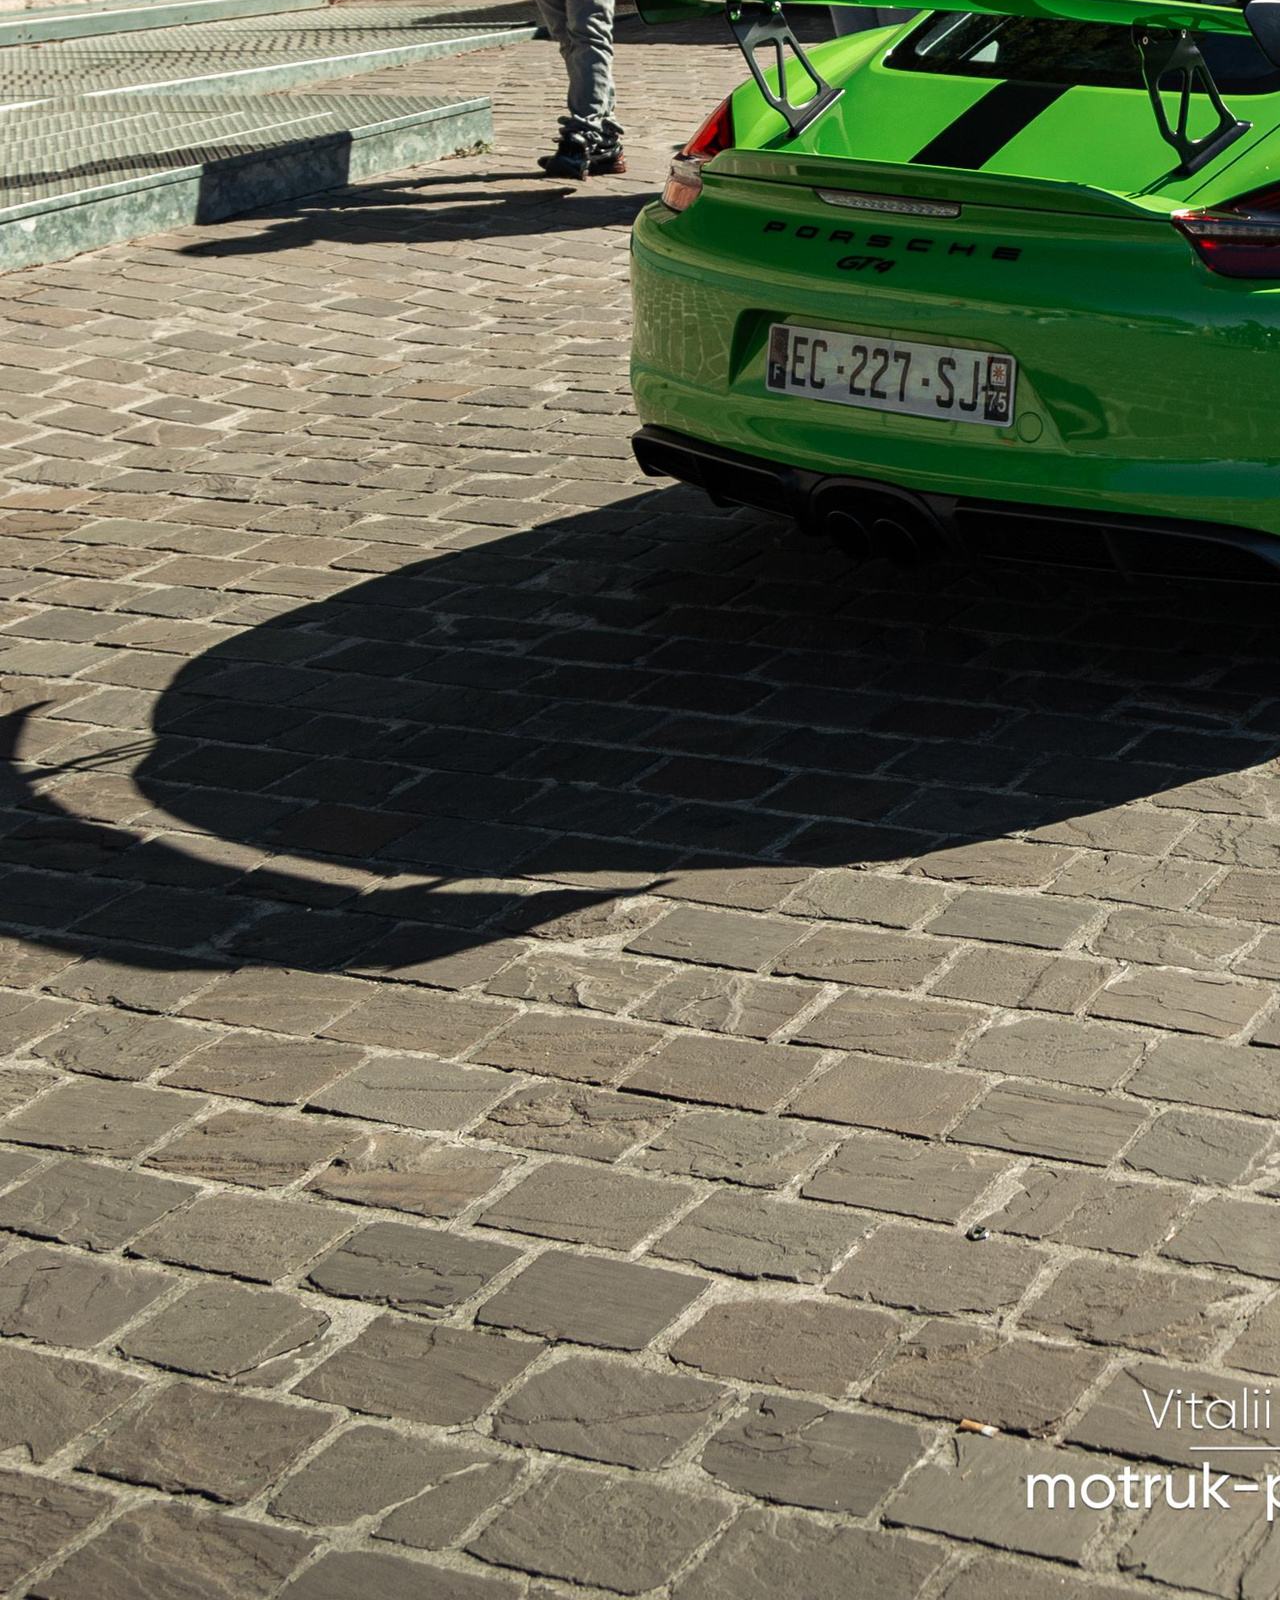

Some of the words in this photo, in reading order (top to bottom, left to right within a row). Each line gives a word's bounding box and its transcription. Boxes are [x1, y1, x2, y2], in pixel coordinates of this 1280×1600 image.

[763, 221, 1022, 261] PORSCHE
[836, 255, 896, 274] GT4
[772, 363, 781, 380] F
[987, 391, 1007, 413] 75
